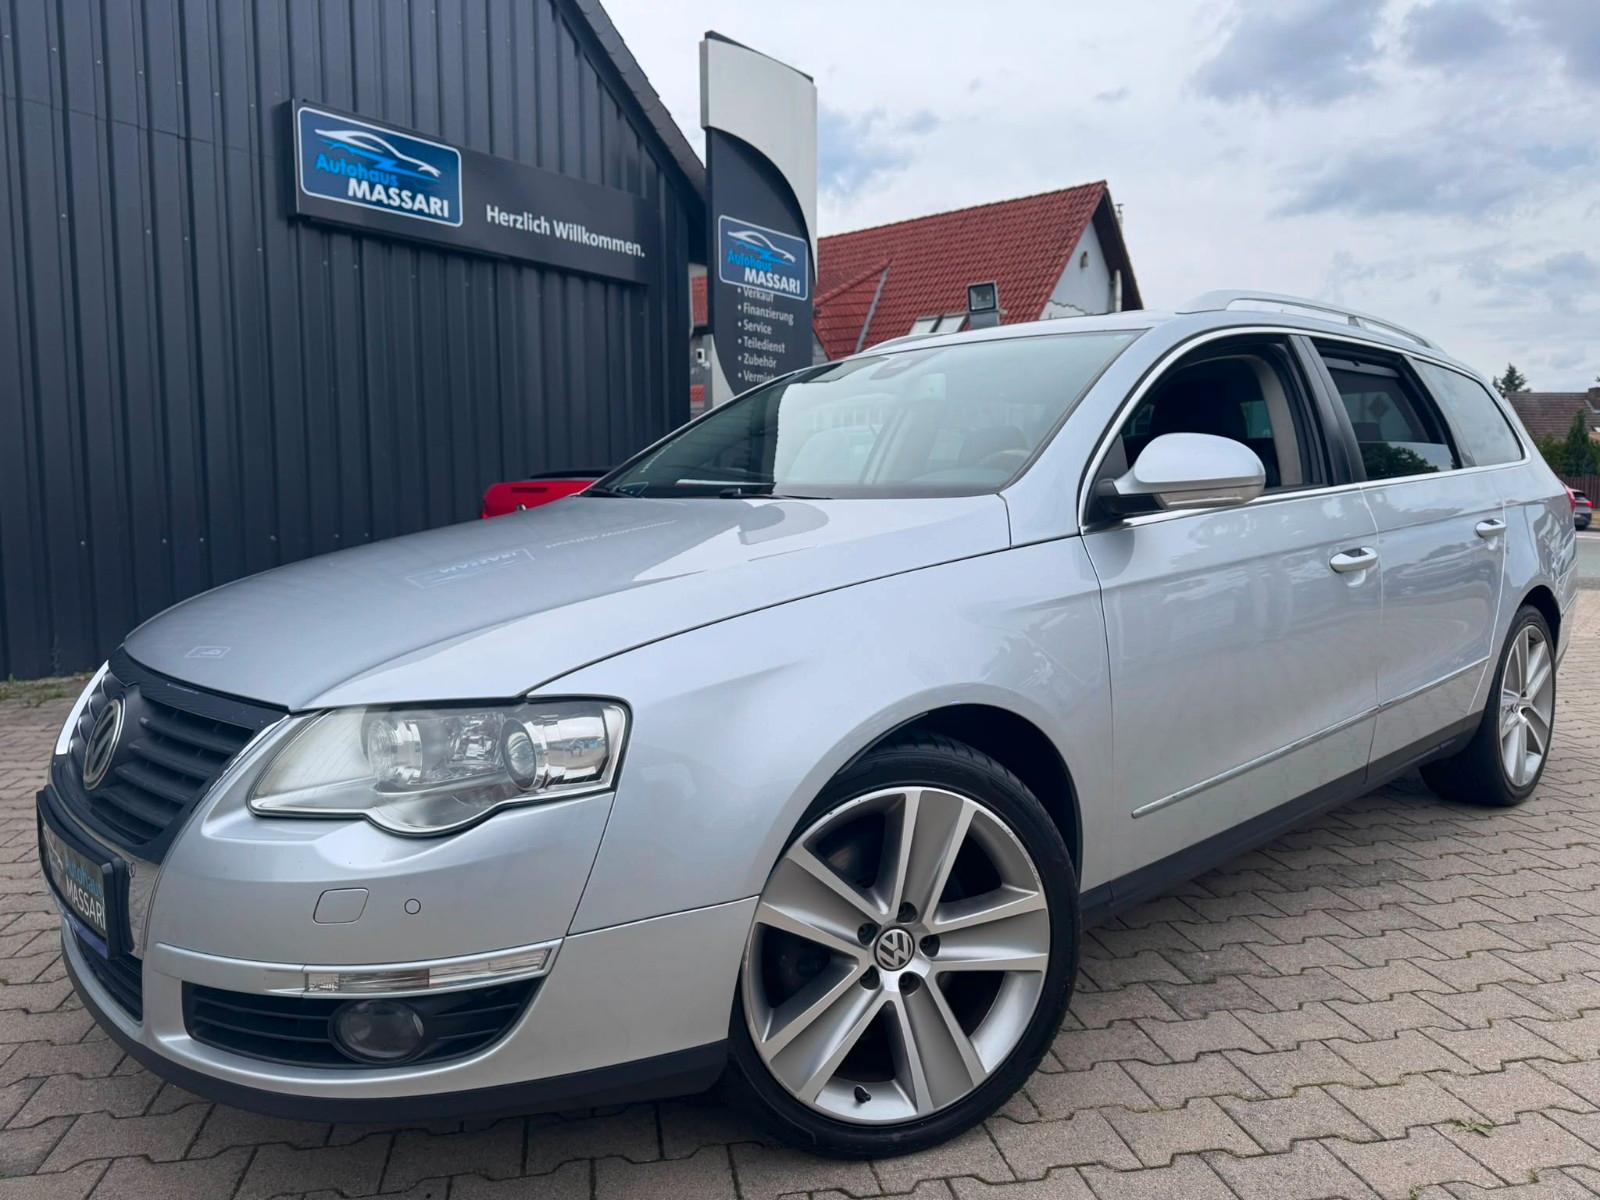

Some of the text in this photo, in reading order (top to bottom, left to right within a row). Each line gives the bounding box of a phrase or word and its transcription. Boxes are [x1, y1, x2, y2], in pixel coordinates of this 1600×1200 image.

[315, 152, 399, 187] Autohaus
[347, 177, 450, 219] MASSARI
[485, 204, 646, 257] Herzlich Willkommen.
[727, 249, 772, 271] Autohaus
[744, 267, 801, 294] MASSARI
[743, 286, 774, 303] Verkauf
[743, 303, 794, 326] Finanzierung
[743, 321, 772, 335] Service
[743, 336, 786, 354] Teiledienst
[743, 352, 777, 369] Zubehör
[66, 874, 106, 930] MASSARI
